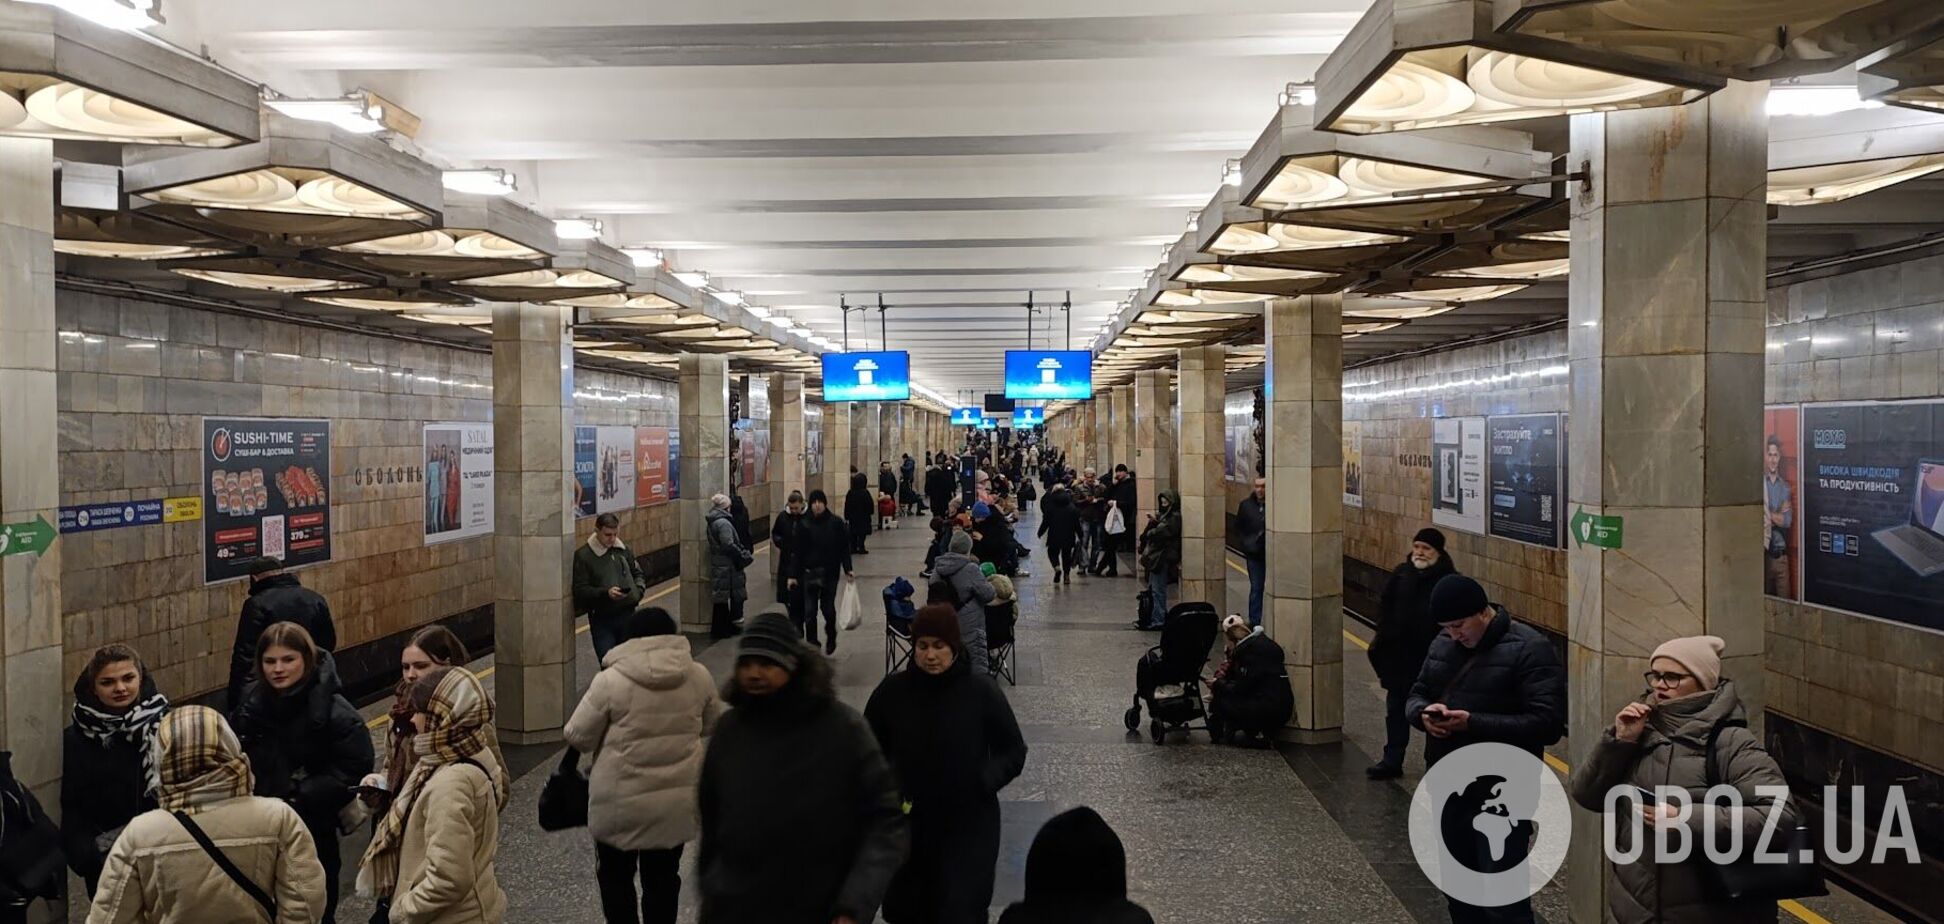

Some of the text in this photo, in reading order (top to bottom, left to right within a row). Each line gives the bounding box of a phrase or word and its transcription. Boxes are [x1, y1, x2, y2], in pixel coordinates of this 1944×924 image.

[234, 432, 294, 444] SUSHI-TIME
[1814, 429, 1846, 447] MOYO
[355, 466, 422, 486] ОБОЛОНЬ
[1819, 465, 1900, 480] ВИСОКА ШВИДКОДІЯ
[1819, 478, 1900, 493] ТА ПРОДУКТИВНІСТЬ
[217, 548, 229, 558] 49
